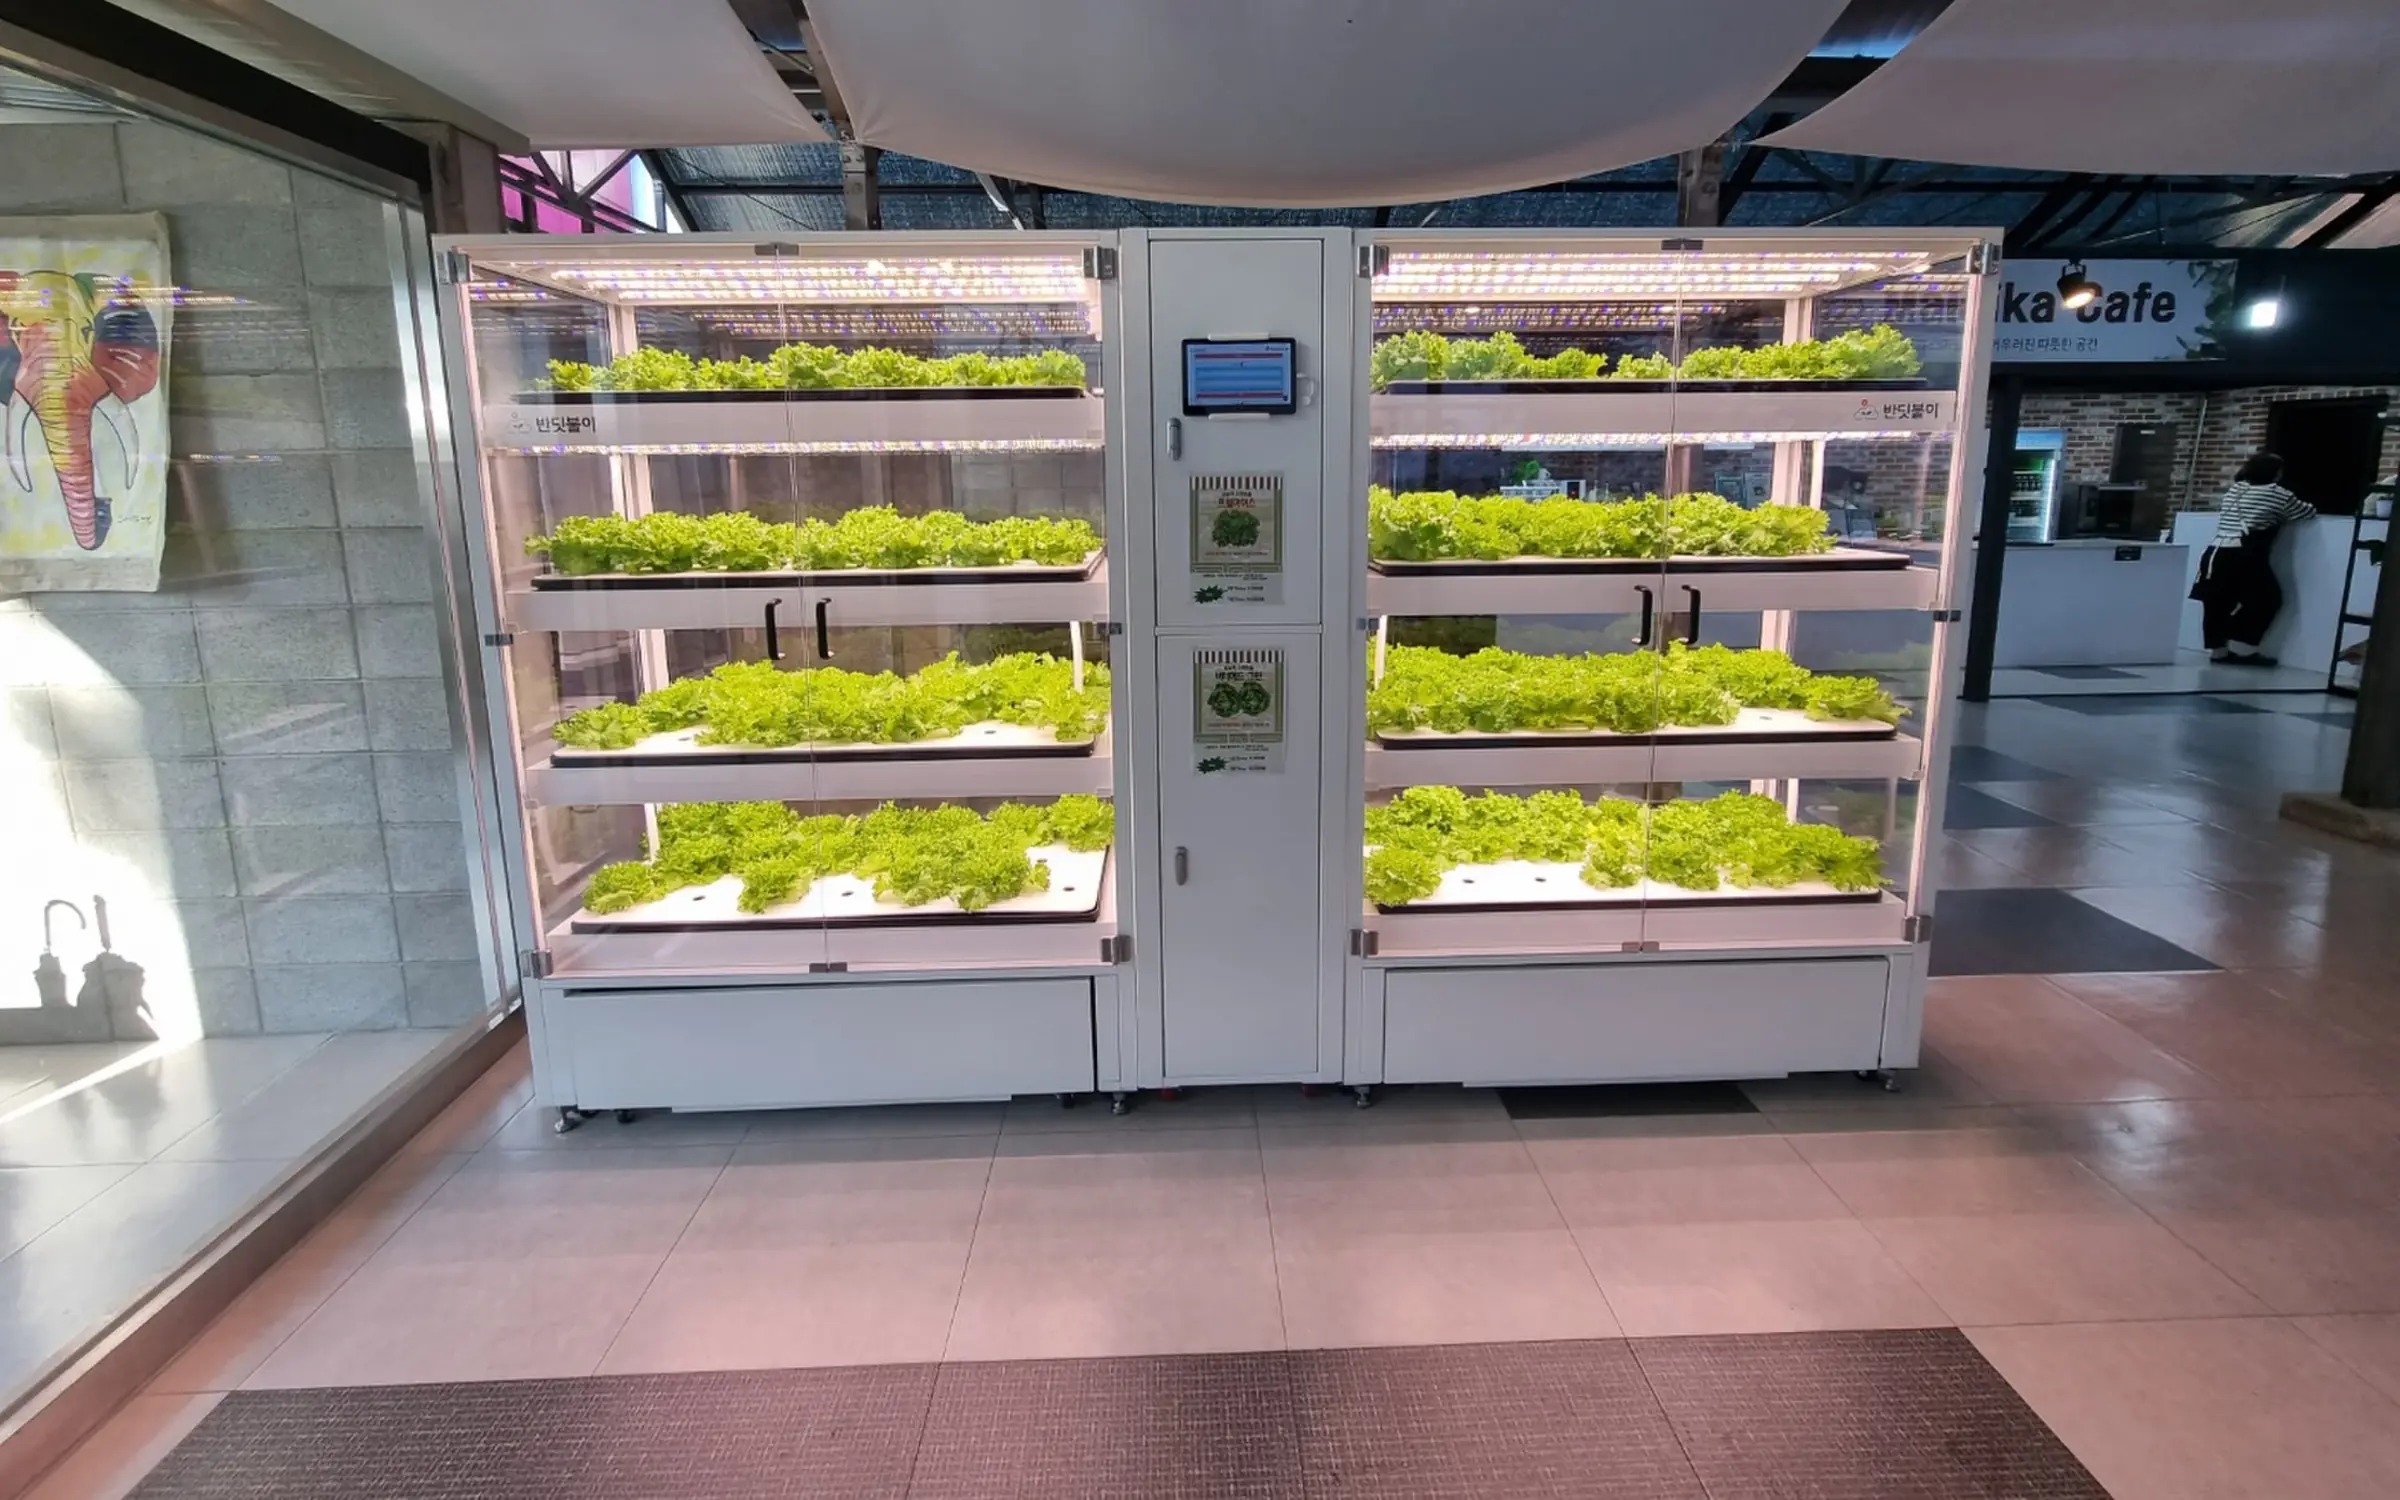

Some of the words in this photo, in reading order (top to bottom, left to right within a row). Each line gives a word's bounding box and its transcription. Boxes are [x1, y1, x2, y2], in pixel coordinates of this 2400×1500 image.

[2076, 337, 2098, 352] 공간
[1883, 403, 1939, 419] 반딧불이
[535, 416, 596, 433] 반딧불이
